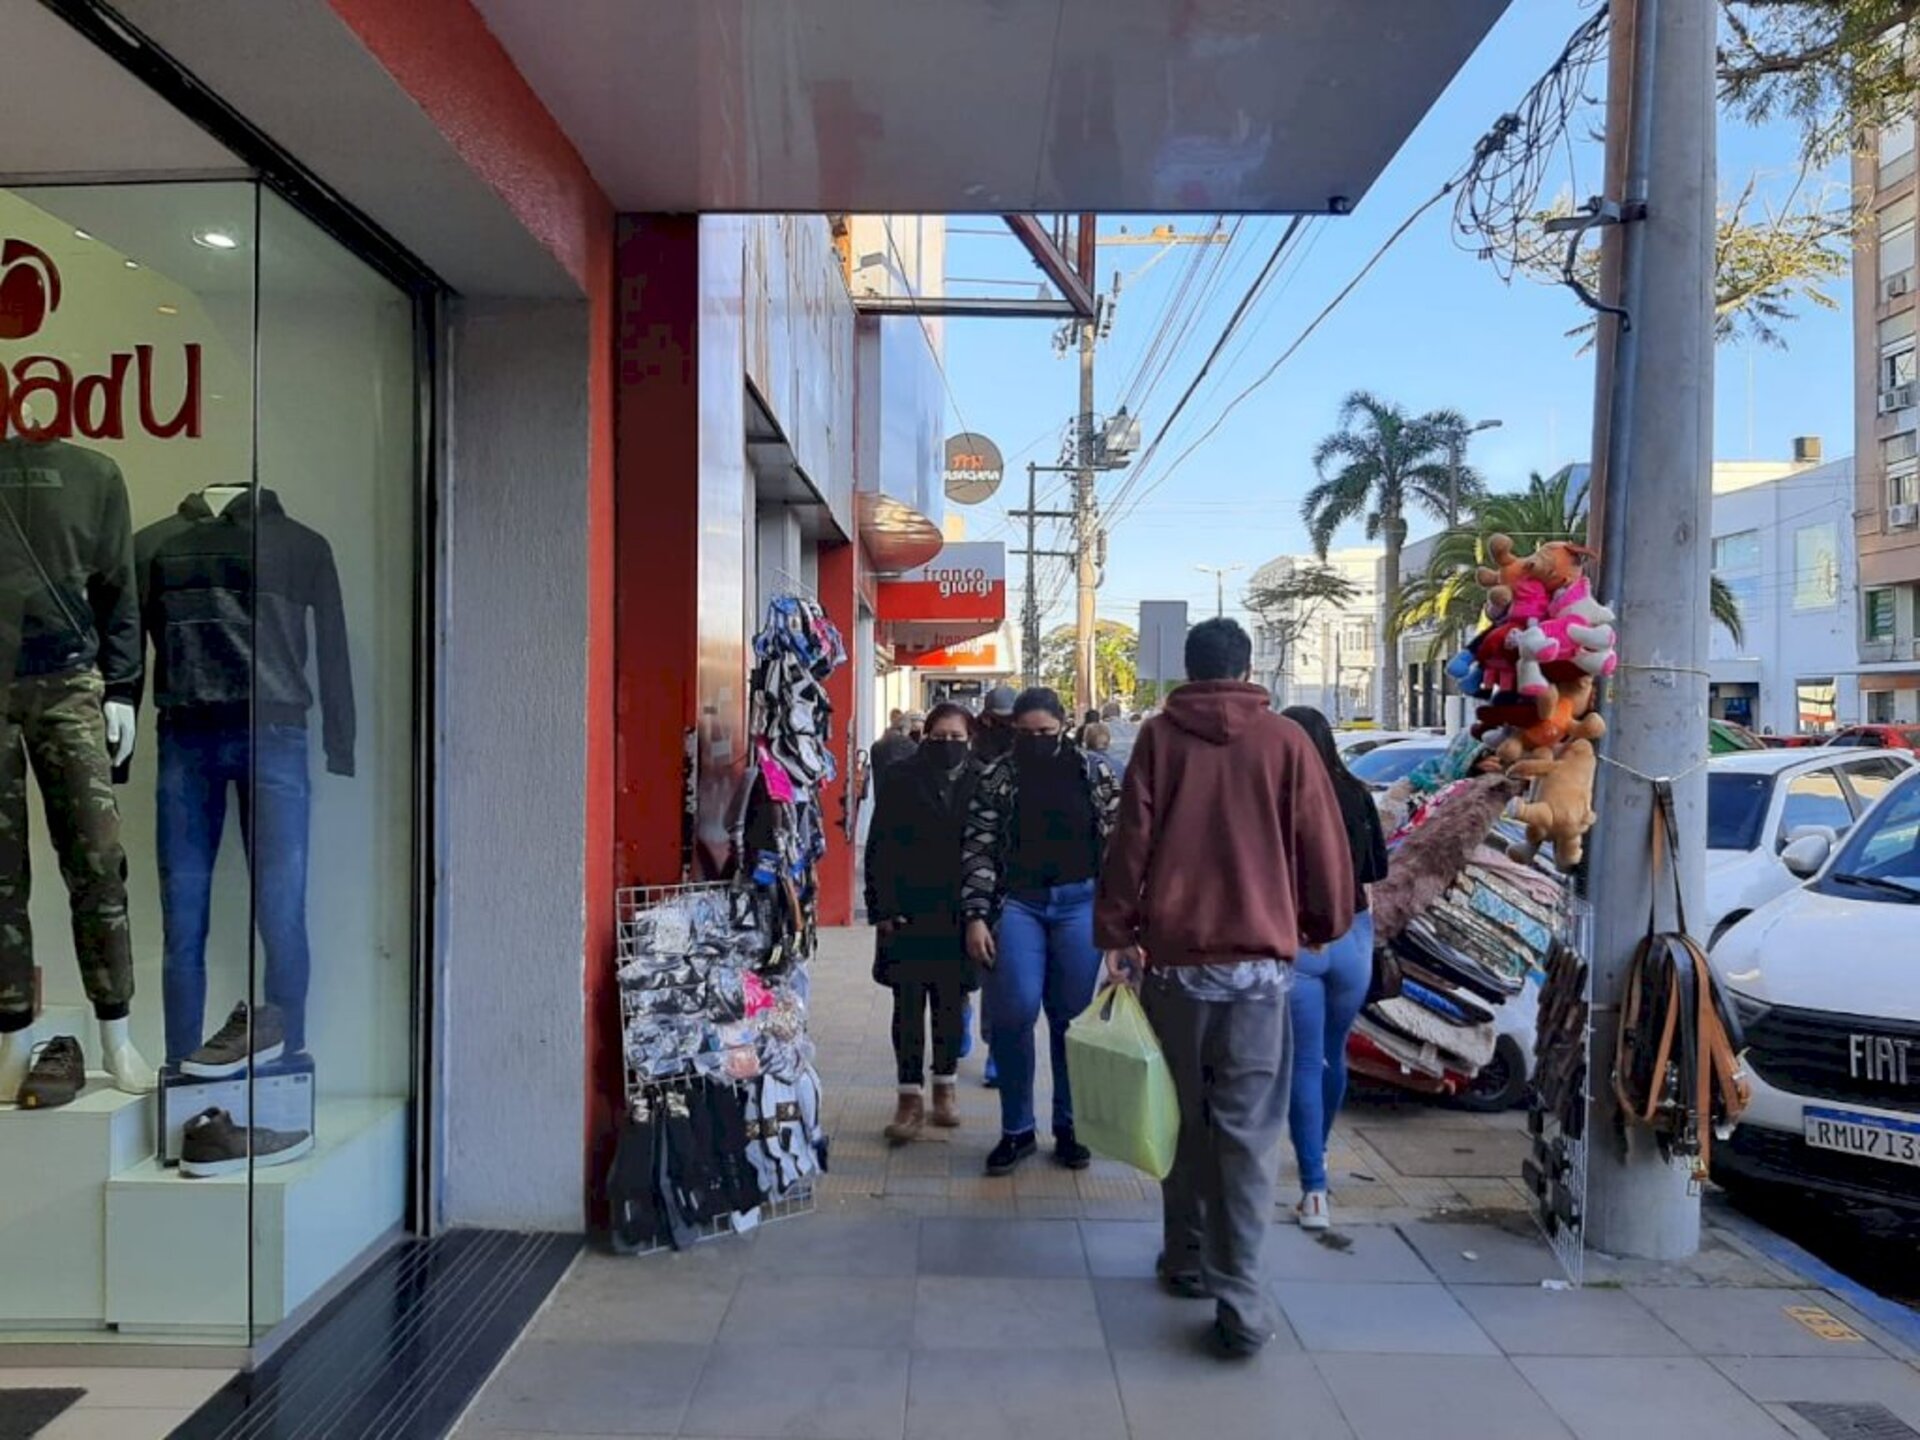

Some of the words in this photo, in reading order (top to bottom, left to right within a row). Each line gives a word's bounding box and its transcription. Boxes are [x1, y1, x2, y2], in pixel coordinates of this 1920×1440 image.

[923, 564, 985, 581] franco
[939, 579, 993, 598] giorgi
[1850, 1034, 1911, 1085] FIAT
[1818, 1121, 1920, 1160] RMU7I3
